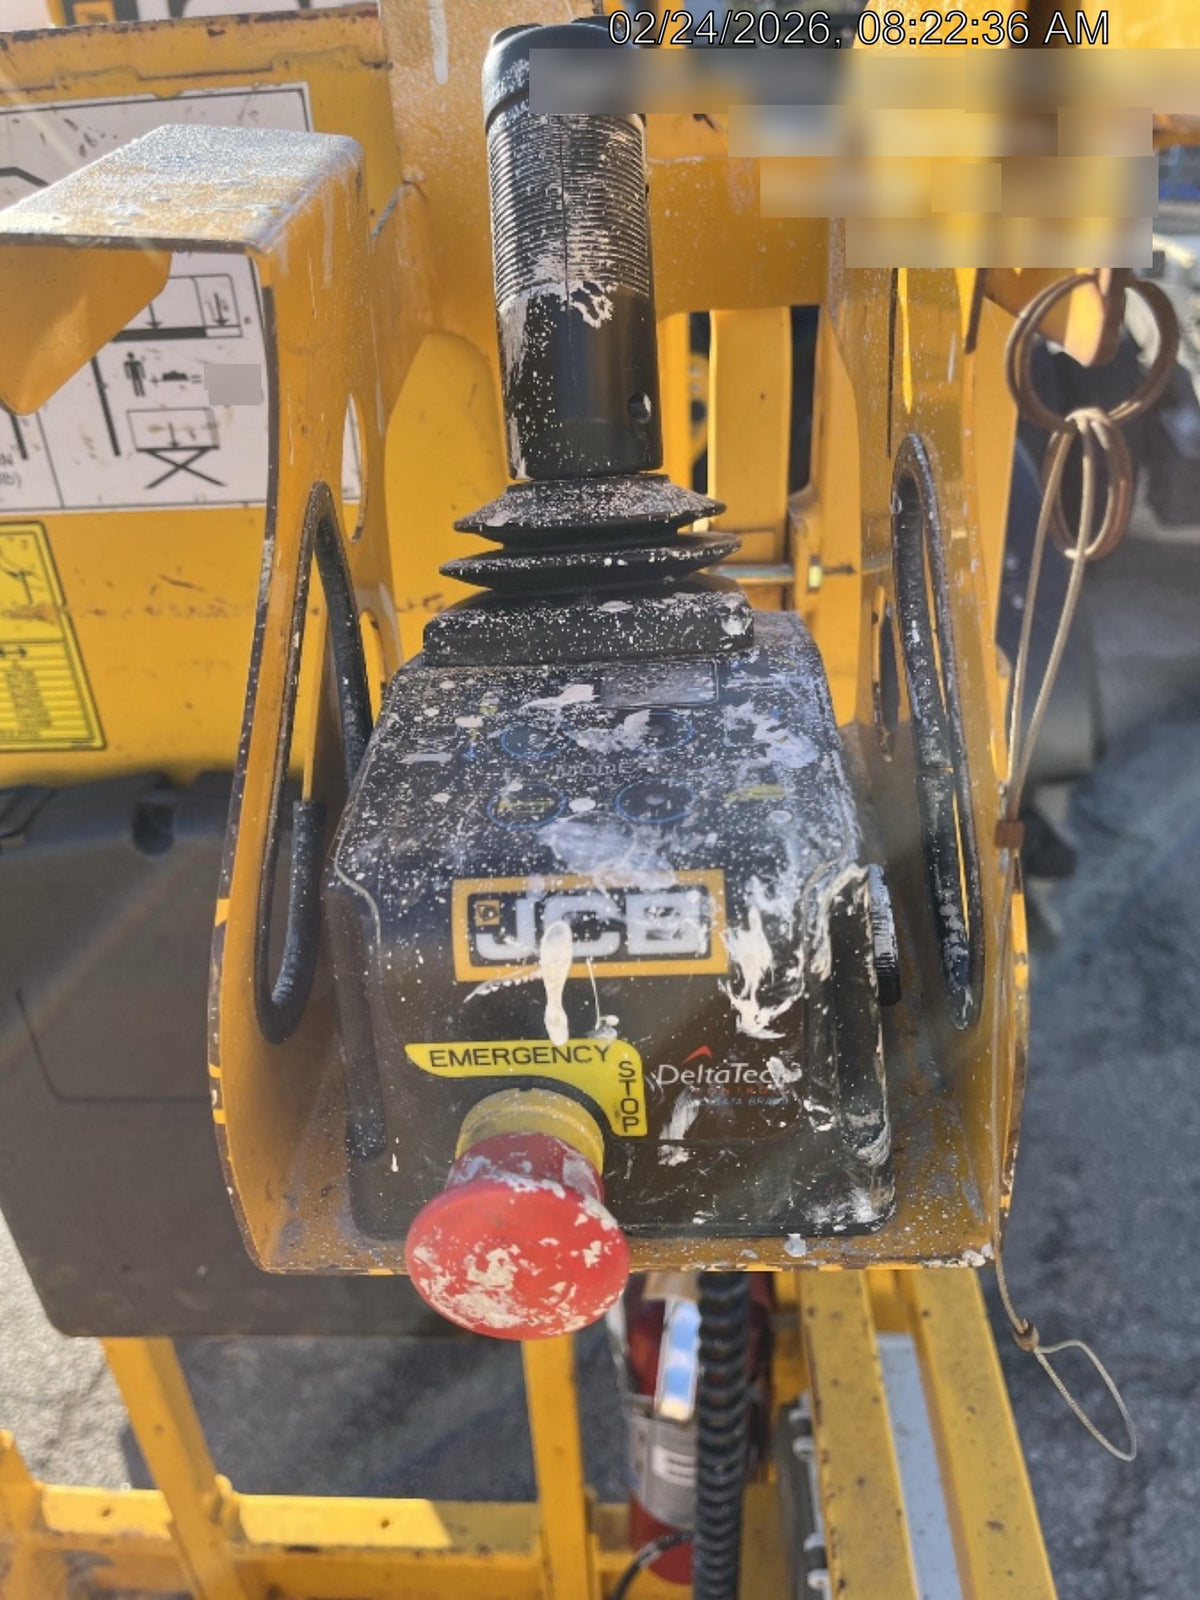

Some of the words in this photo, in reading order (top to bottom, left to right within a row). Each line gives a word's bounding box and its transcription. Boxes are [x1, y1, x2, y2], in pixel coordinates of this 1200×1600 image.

[474, 892, 705, 957] JCB
[428, 1044, 609, 1067] EMERGENCY
[657, 1063, 787, 1085] DeltaTec
[617, 1060, 640, 1133] STOP
